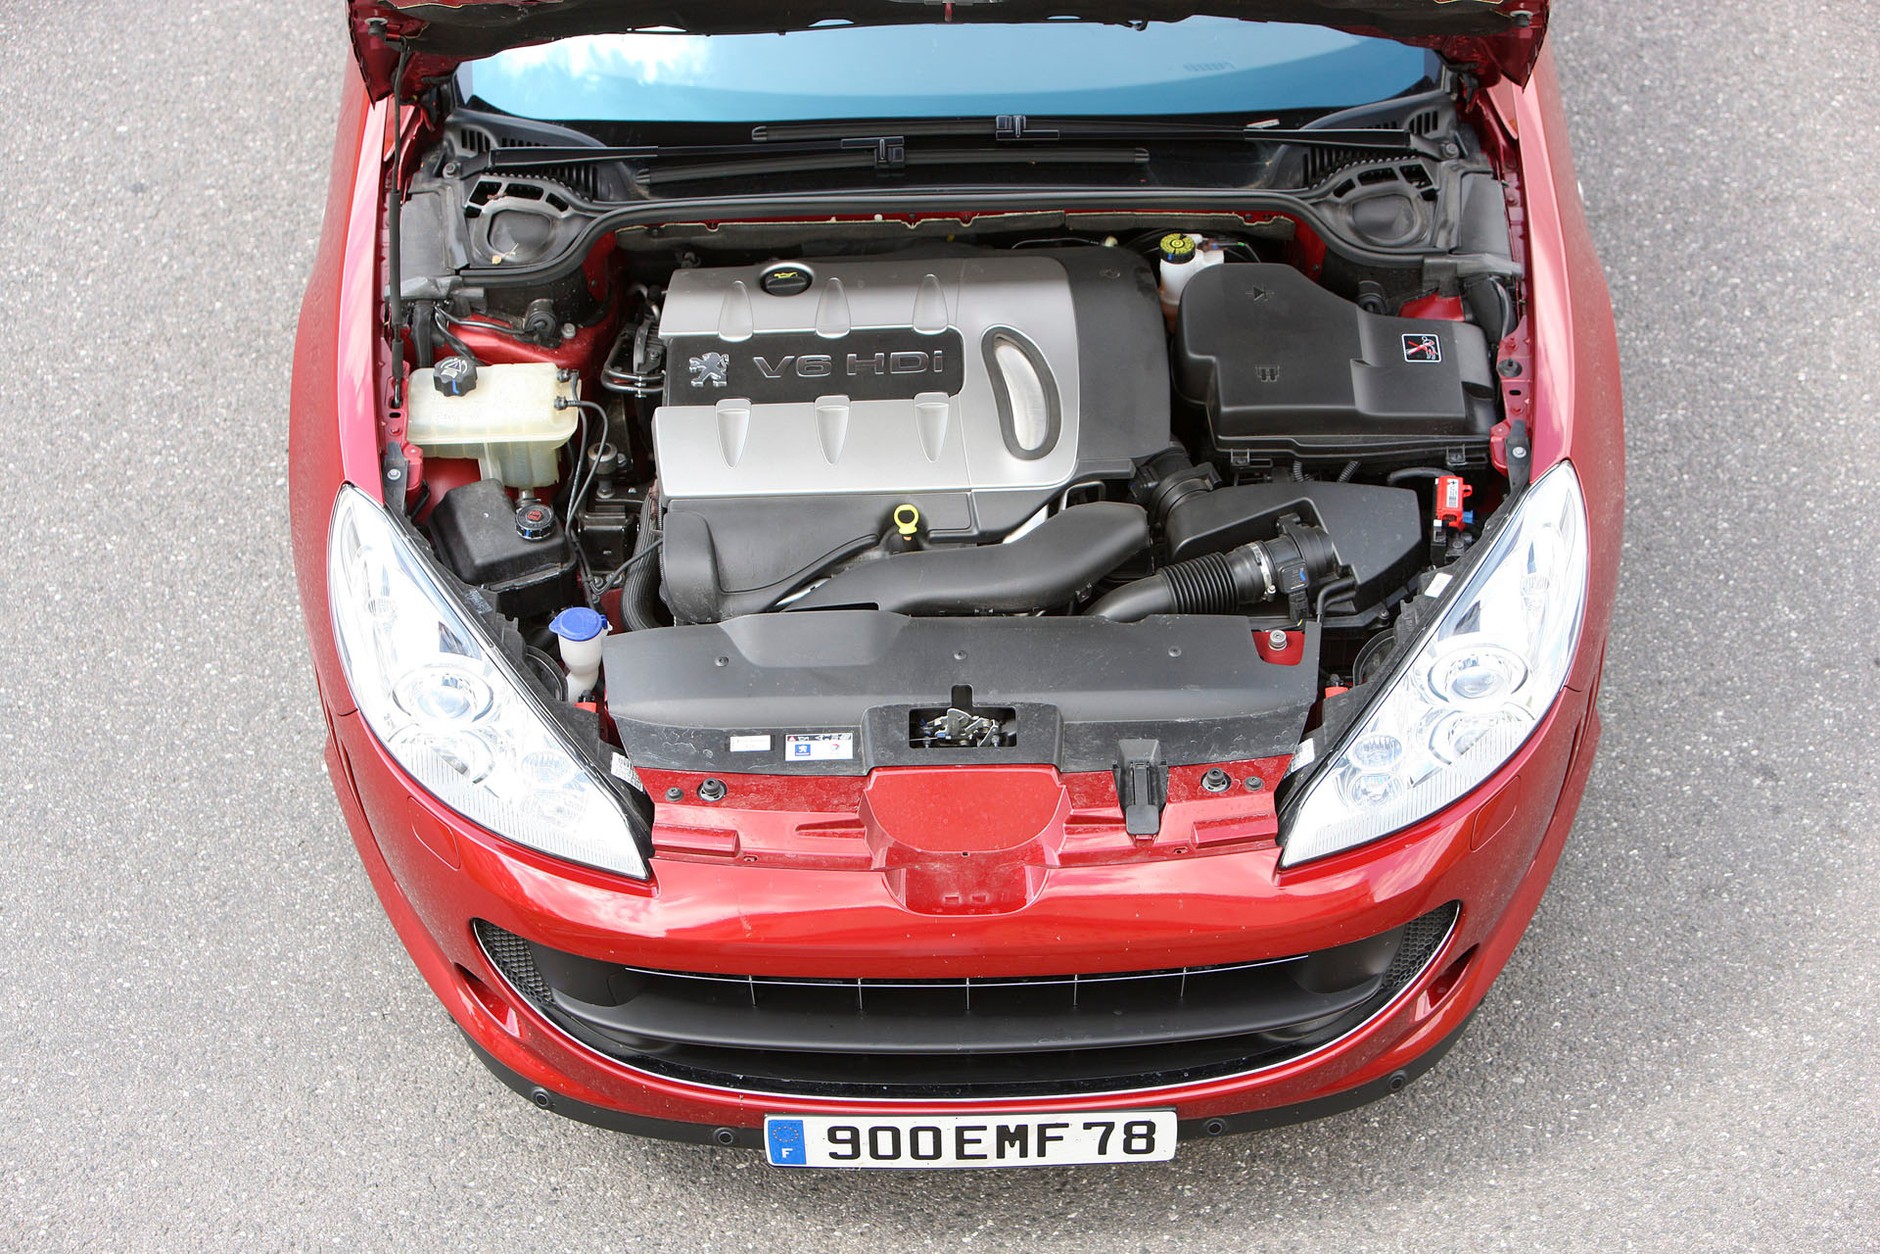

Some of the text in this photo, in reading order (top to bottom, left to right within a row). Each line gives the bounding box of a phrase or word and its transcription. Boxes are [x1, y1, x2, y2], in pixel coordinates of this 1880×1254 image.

[753, 350, 943, 378] V6 HDi
[1082, 1120, 1157, 1155] 78
[781, 1147, 793, 1158] F
